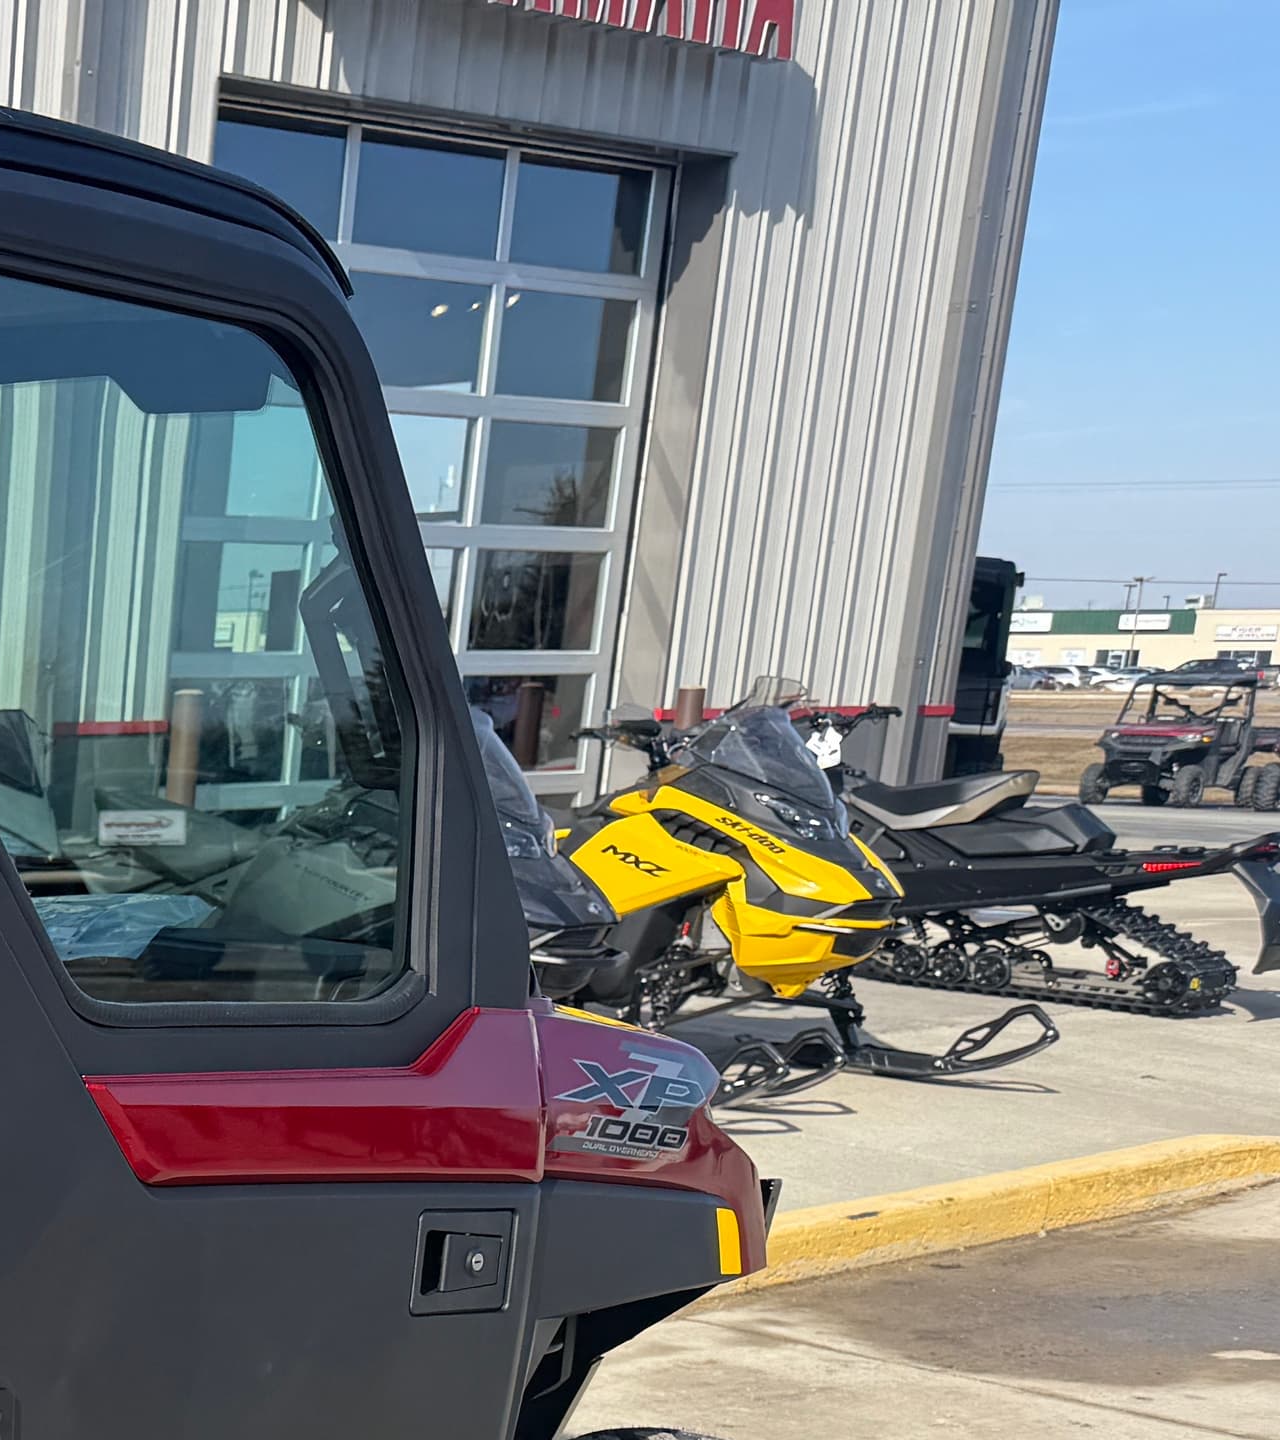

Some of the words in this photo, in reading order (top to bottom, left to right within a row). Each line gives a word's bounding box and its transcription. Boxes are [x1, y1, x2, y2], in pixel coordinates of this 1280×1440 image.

[601, 844, 672, 877] MXZ
[552, 1058, 706, 1114] XP
[586, 1115, 689, 1151] 1000
